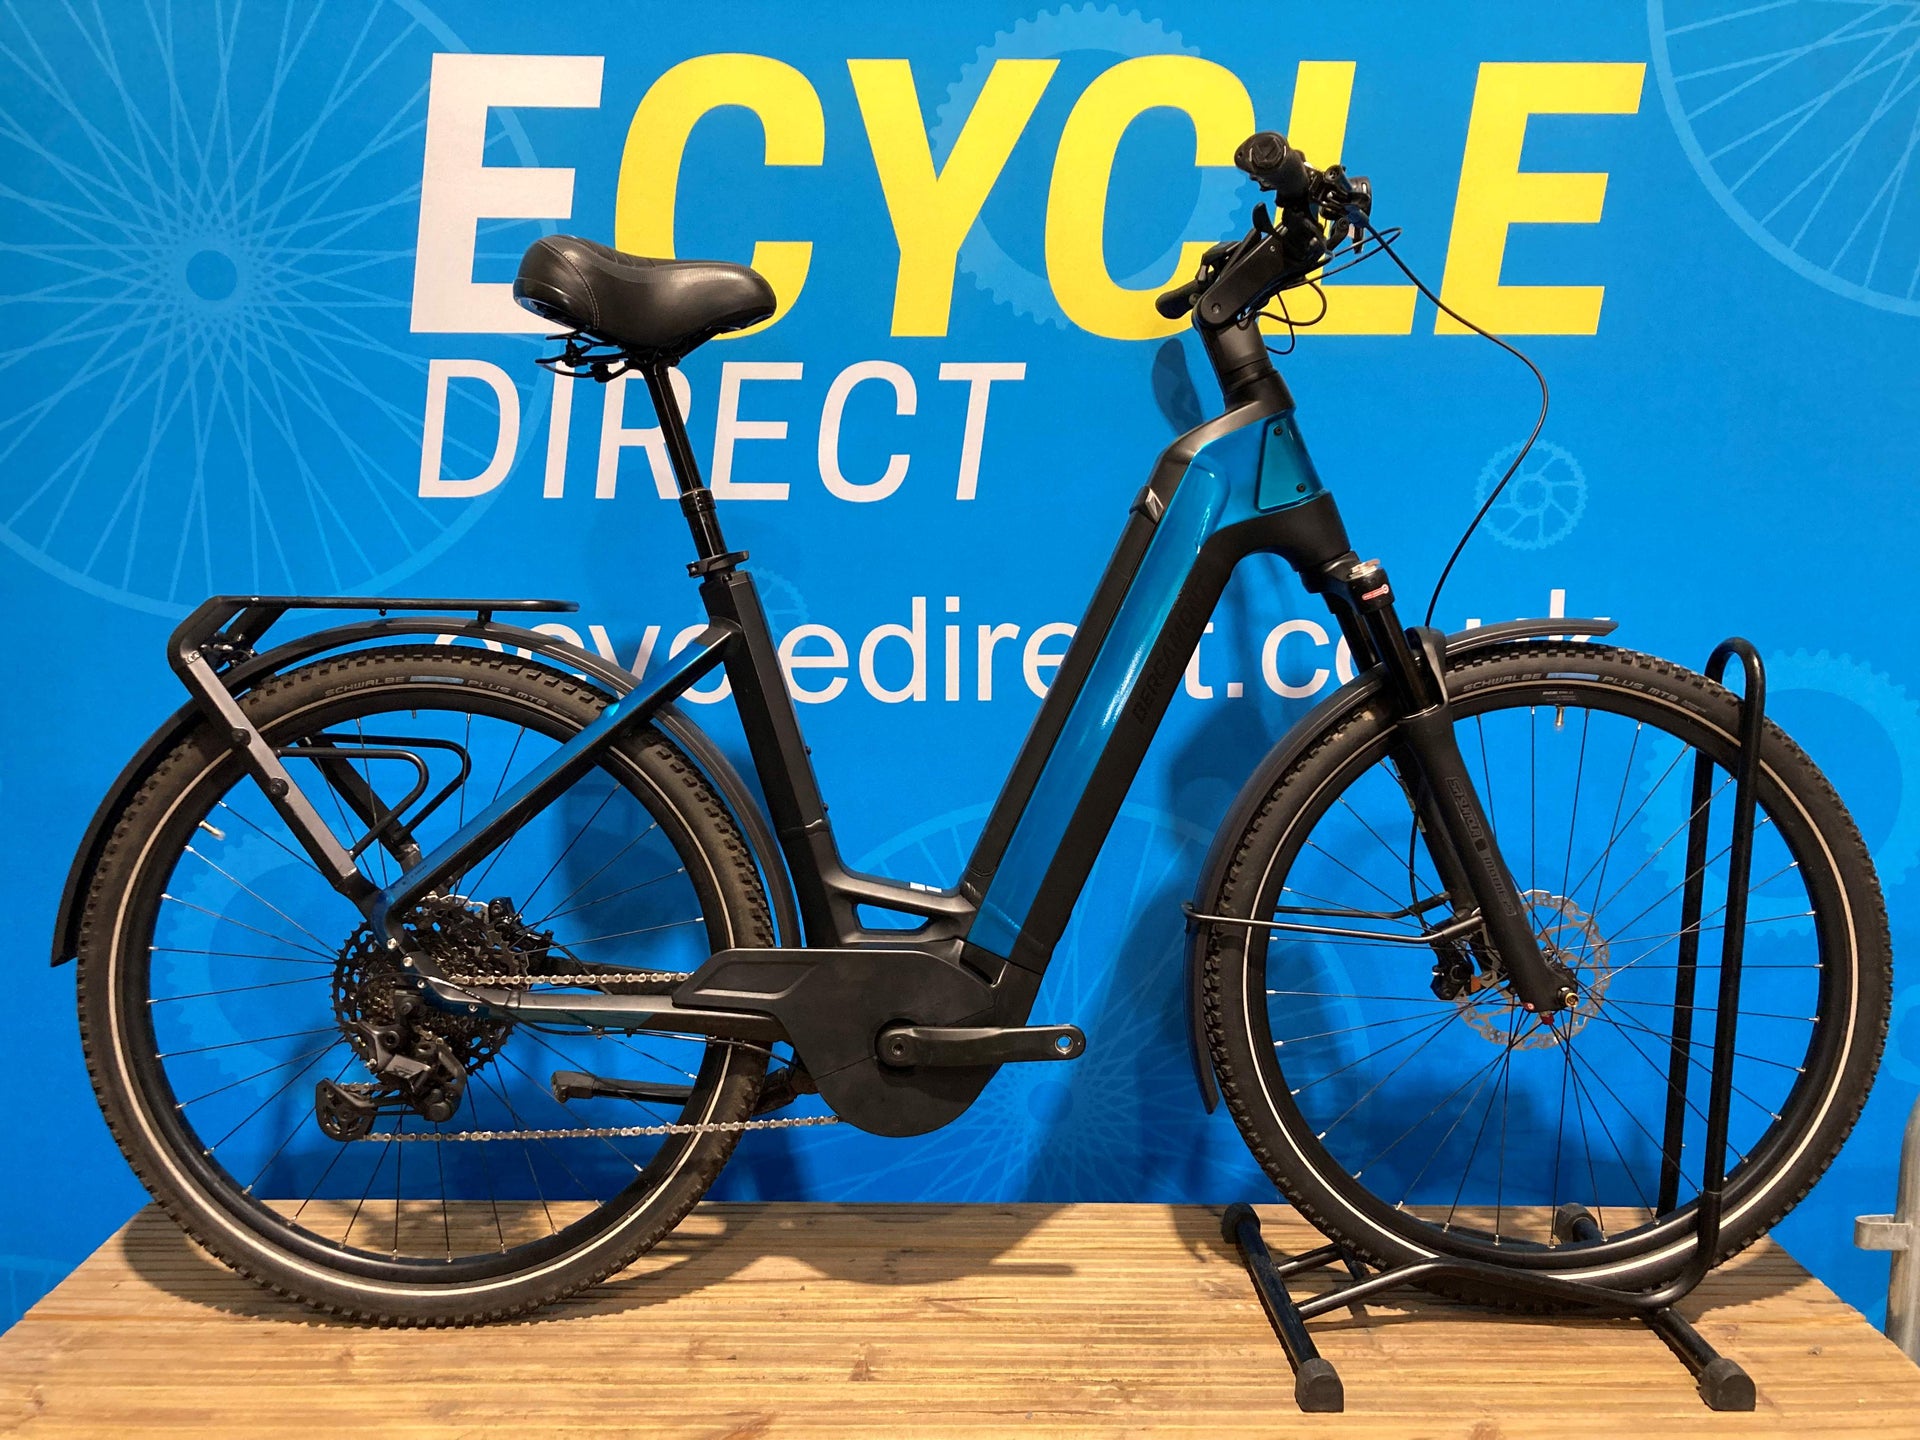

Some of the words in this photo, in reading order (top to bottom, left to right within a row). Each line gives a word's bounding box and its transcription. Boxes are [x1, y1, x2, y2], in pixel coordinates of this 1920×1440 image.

[410, 53, 1646, 340] ECYCLE
[418, 359, 1026, 502] DIRECT
[325, 676, 405, 697] SCHWALBE
[467, 679, 512, 694] PLUS
[1463, 673, 1542, 692] SCHWALBE
[1602, 676, 1645, 690] PLUS
